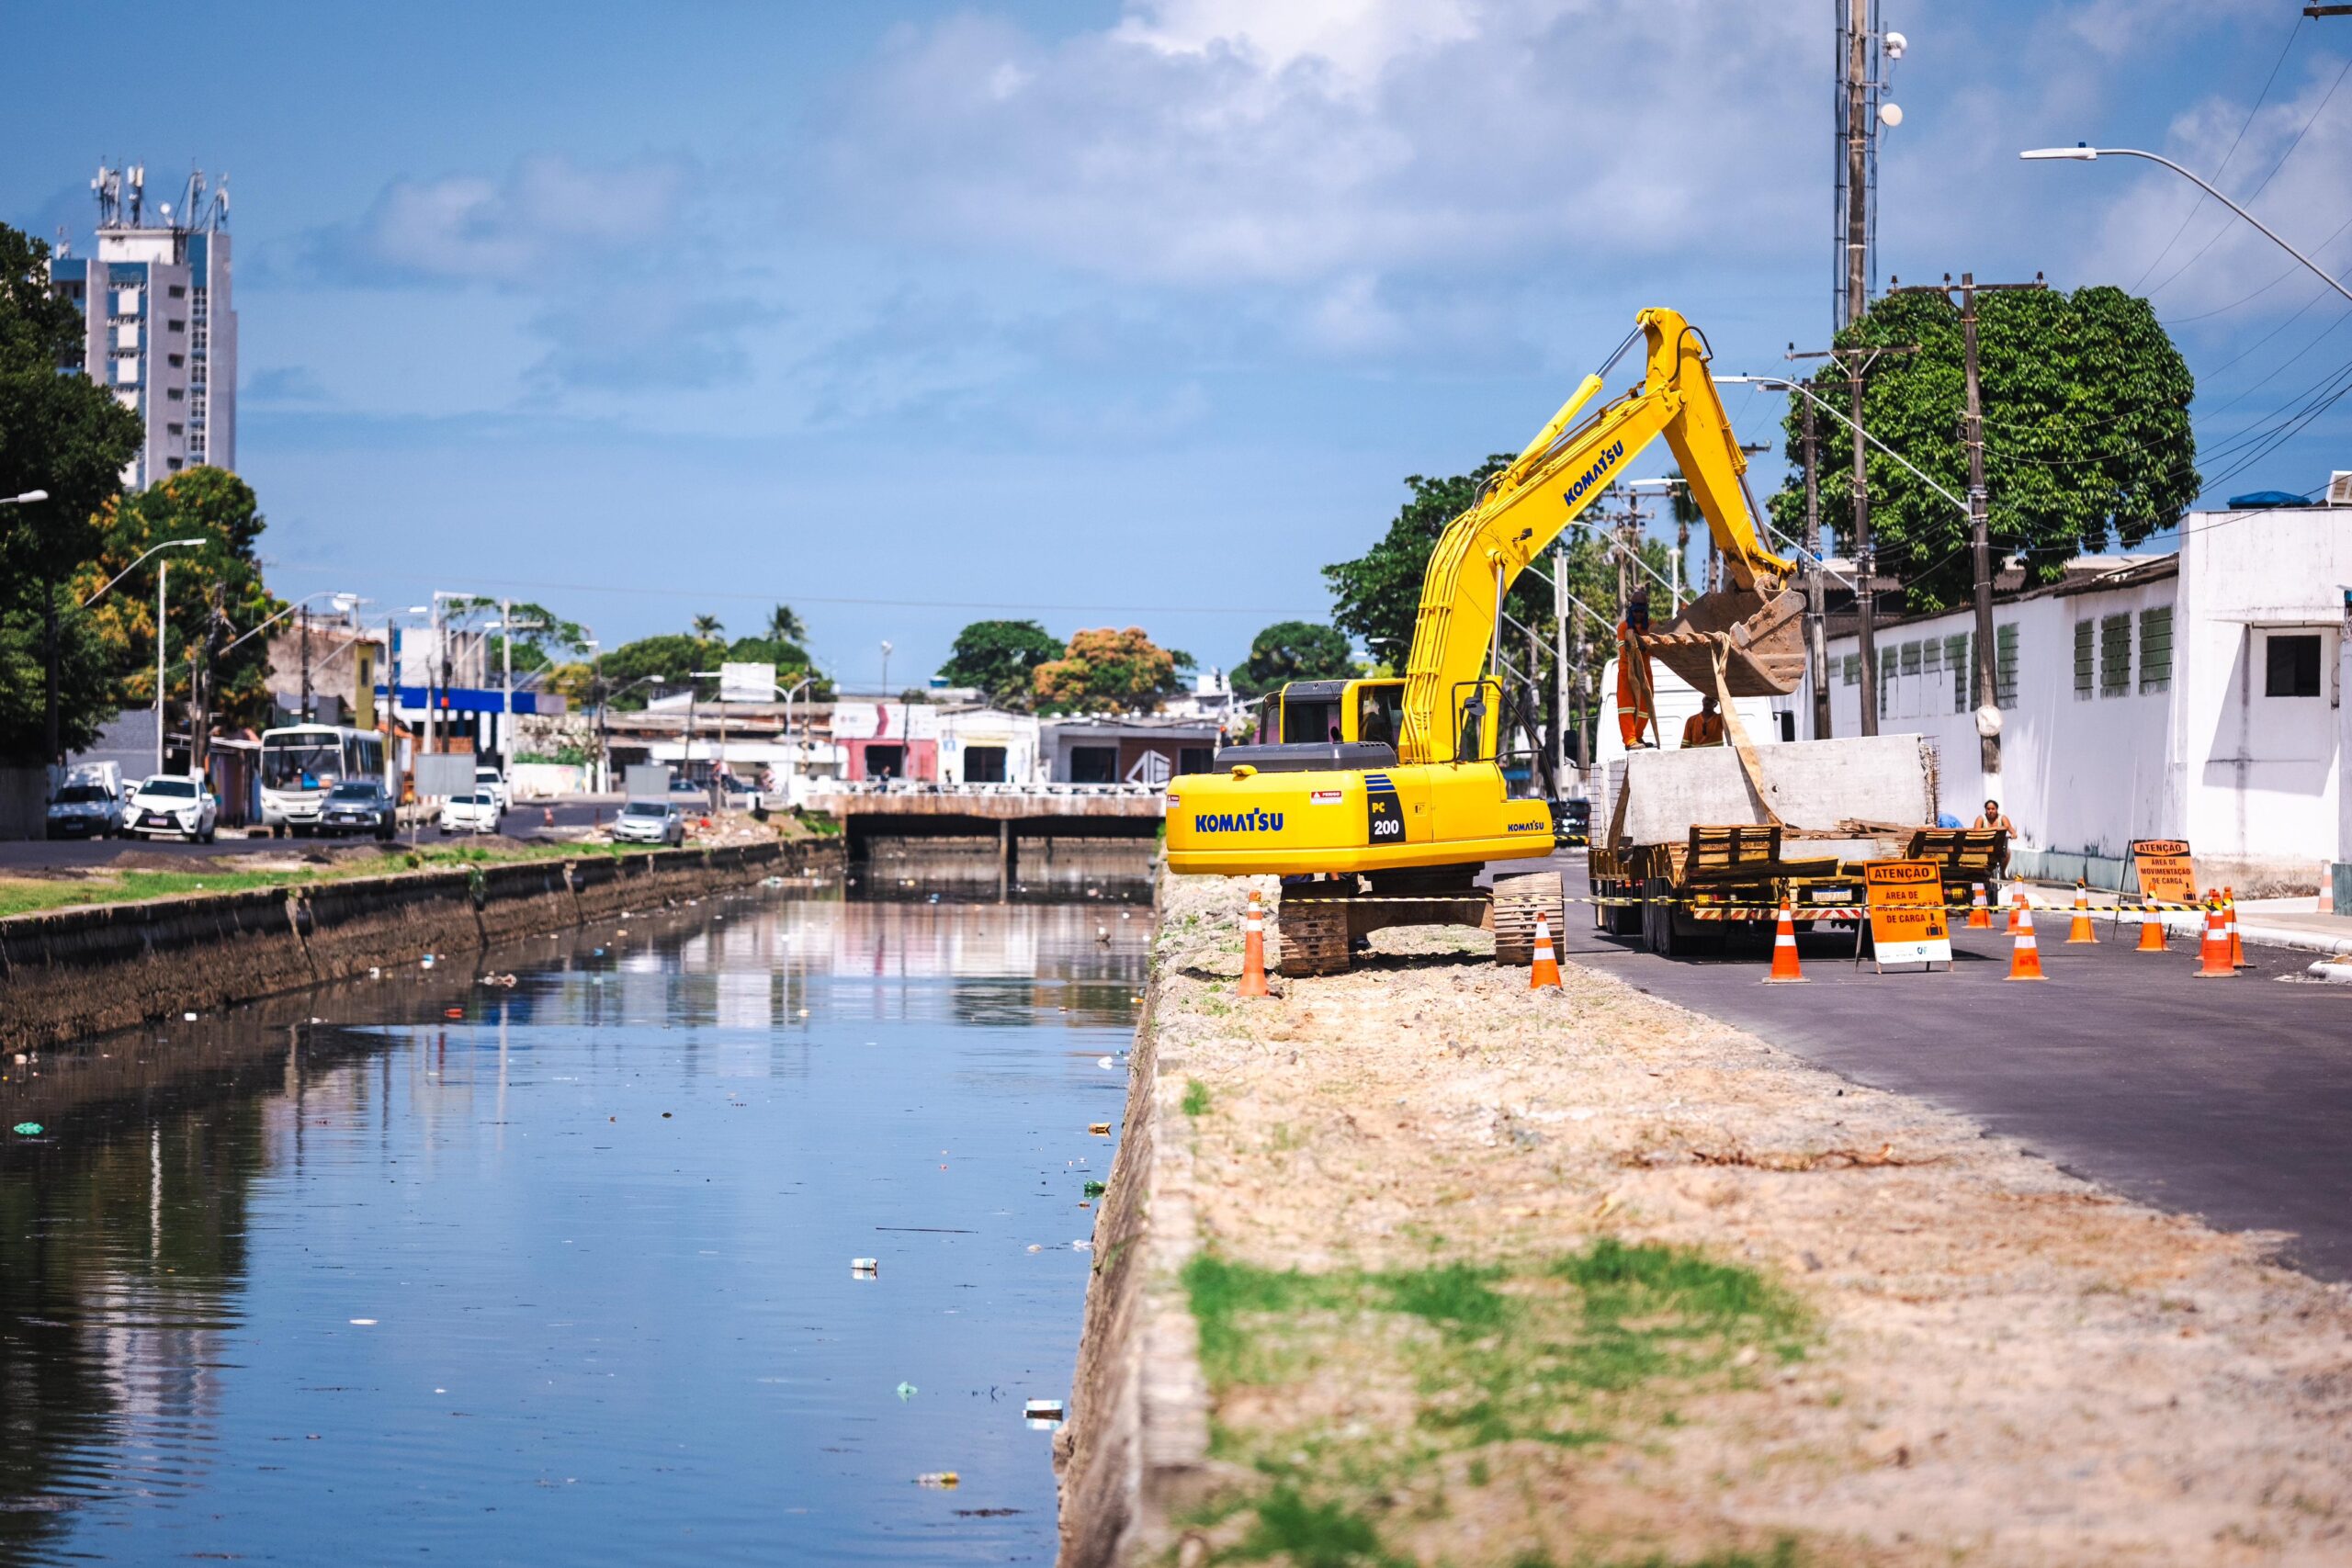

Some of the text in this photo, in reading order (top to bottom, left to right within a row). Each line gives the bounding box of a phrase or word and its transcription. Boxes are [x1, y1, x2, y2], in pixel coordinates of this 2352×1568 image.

[1564, 440, 1623, 507] KOMATSU
[1372, 802, 1385, 813] PC
[1195, 807, 1283, 832] KOMATSU
[1374, 819, 1399, 835] 200
[1508, 820, 1544, 831] KOMATSU
[2140, 843, 2181, 853] ATENÇÃO
[1875, 866, 1928, 880] ATENÇÃO
[1908, 891, 1918, 899] DE
[1886, 914, 1926, 923] DE CARGA
